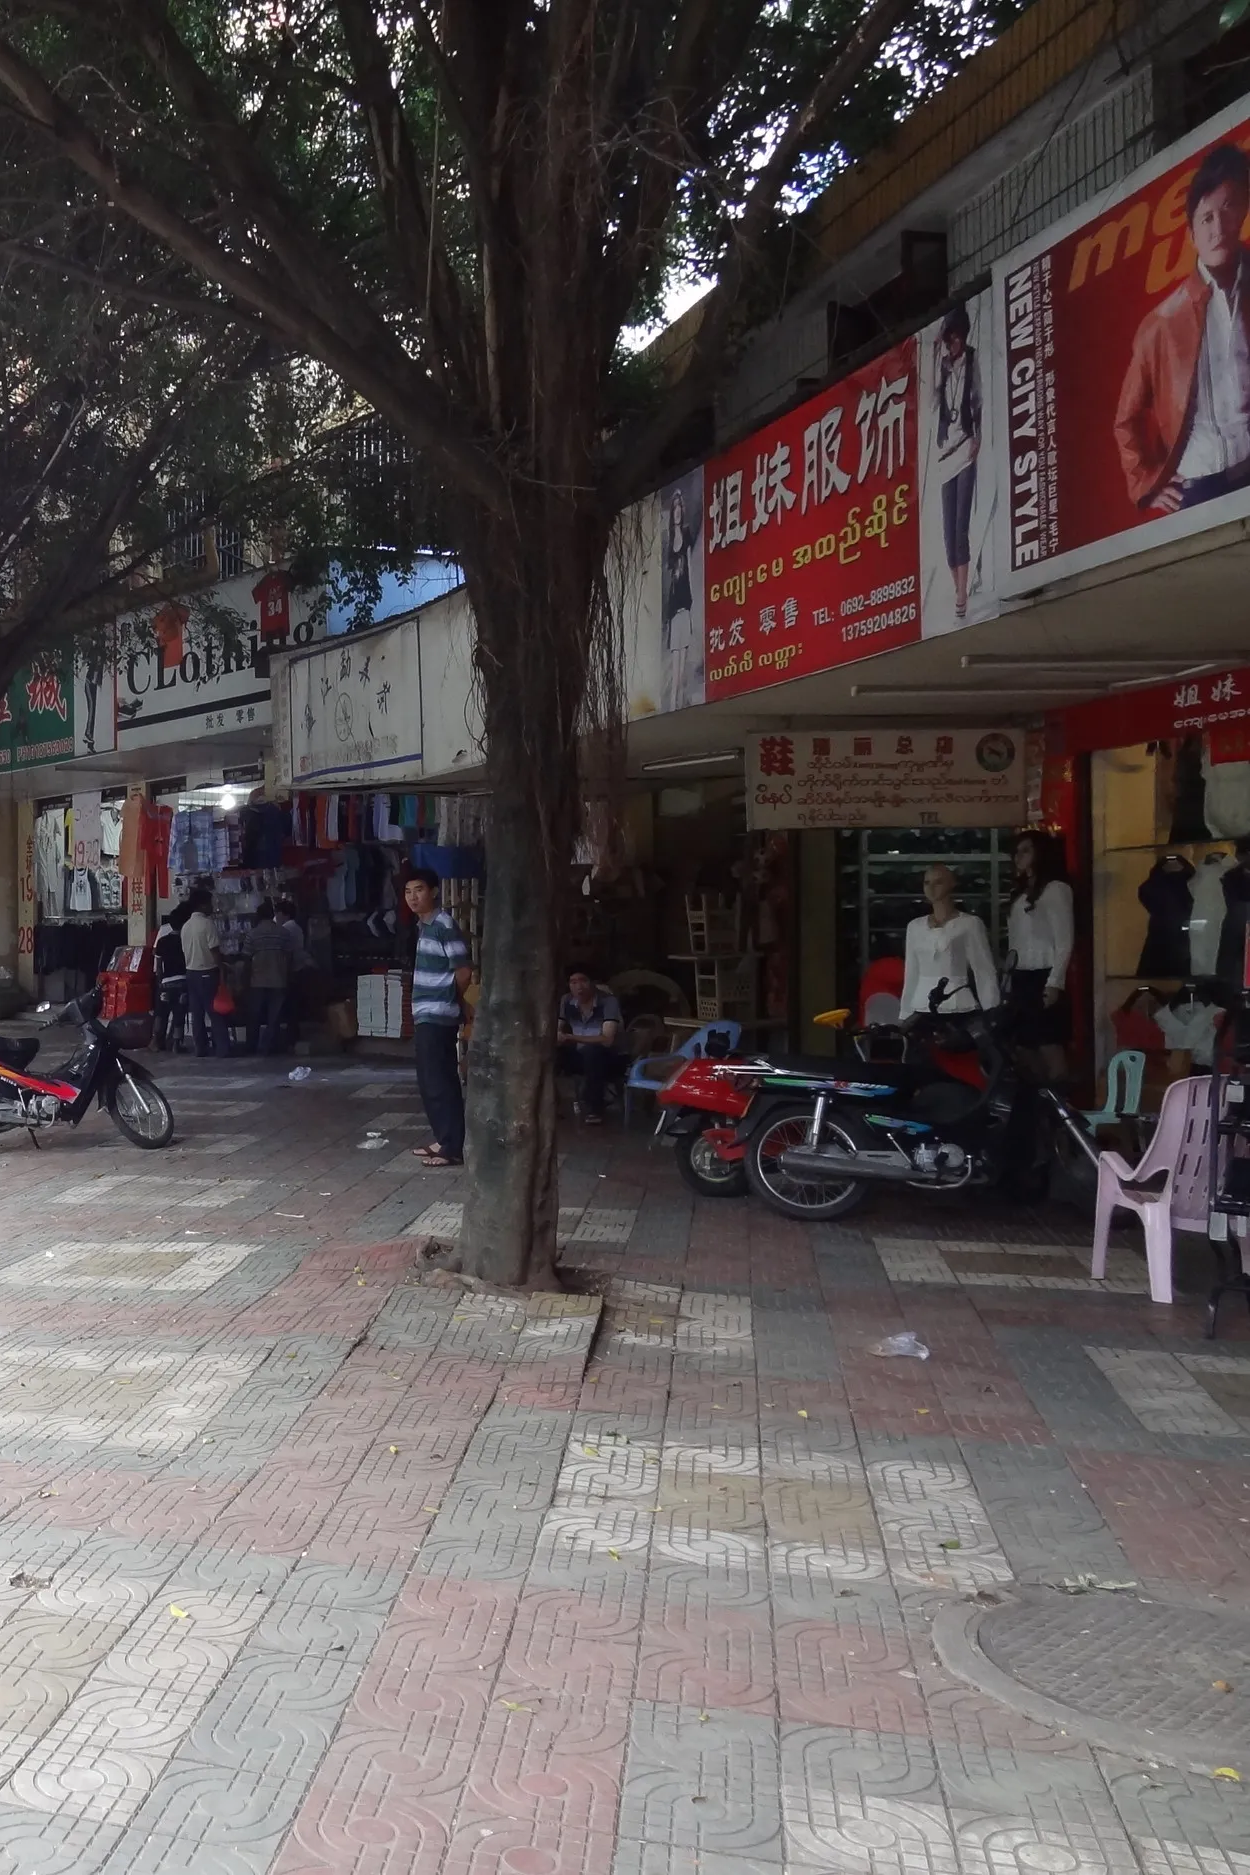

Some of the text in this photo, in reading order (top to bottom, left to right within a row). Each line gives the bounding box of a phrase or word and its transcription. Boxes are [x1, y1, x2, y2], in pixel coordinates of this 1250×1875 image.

[1009, 266, 1039, 567] NEW CITY STYLE
[708, 377, 910, 553] 姐妹服饰
[268, 598, 283, 616] 34
[813, 575, 915, 628] TEL: 0692-8899832
[710, 597, 799, 654] 批发 零售
[841, 603, 916, 641] 13759204826
[1173, 673, 1242, 708] 姐妹
[205, 707, 256, 729] 批发 零售
[920, 812, 940, 824] TEL
[18, 926, 33, 954] 28
